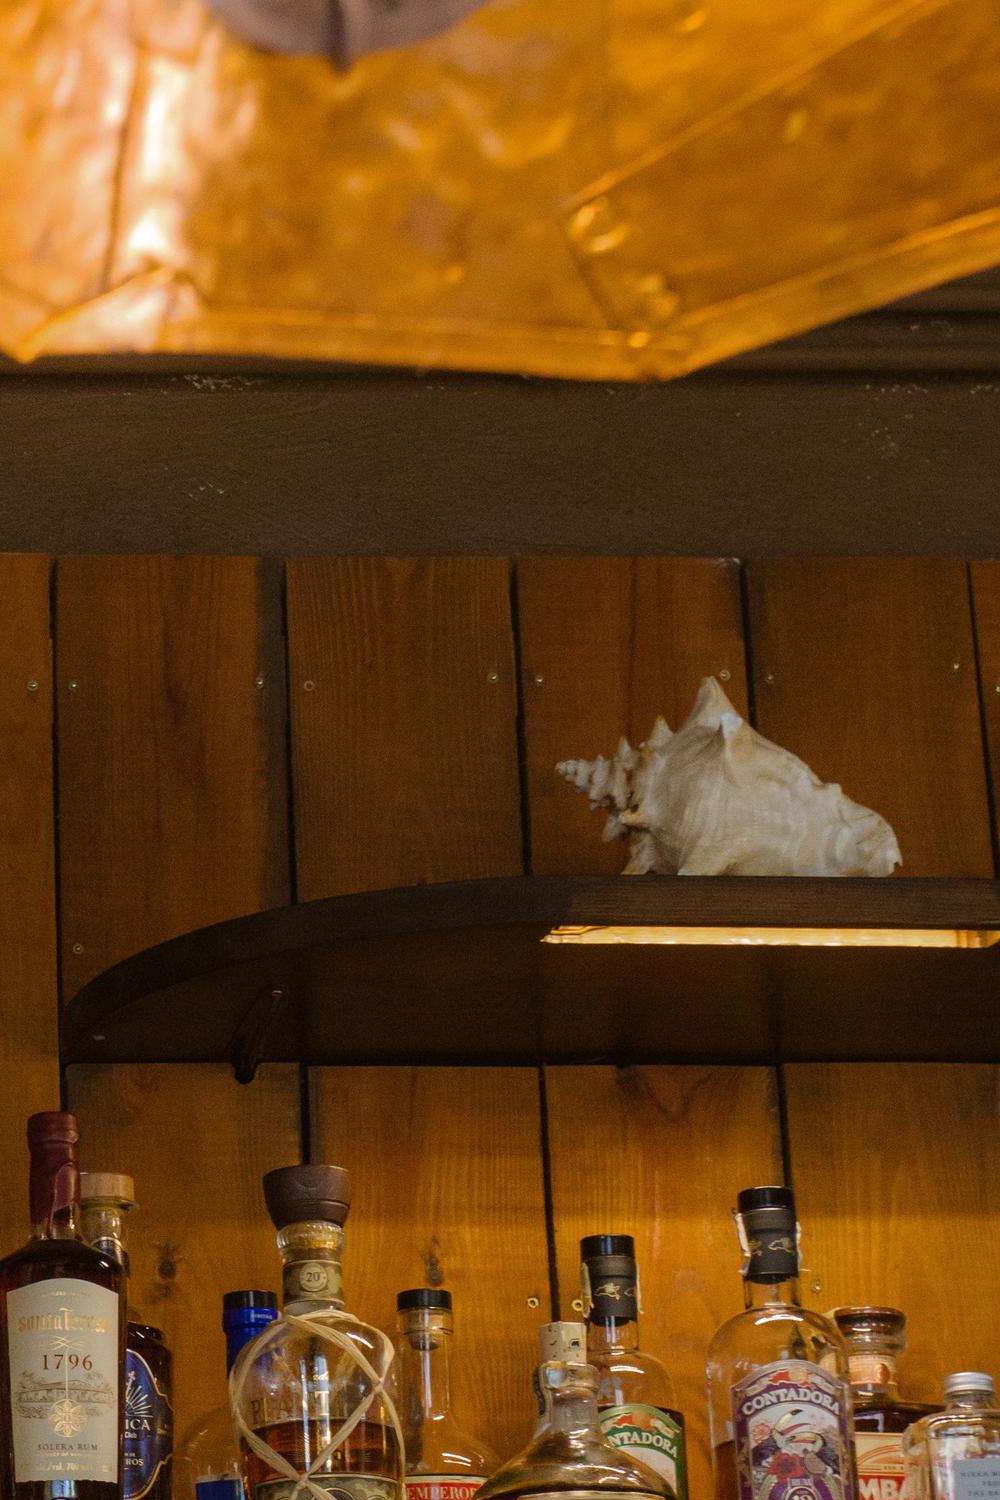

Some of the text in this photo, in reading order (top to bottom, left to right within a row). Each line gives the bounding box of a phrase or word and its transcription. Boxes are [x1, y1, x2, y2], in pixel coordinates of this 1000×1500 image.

[305, 1271, 321, 1282] 20
[42, 1353, 94, 1371] 1796
[742, 1388, 841, 1416] CONTADORA
[37, 1443, 99, 1451] SOLERA RUM
